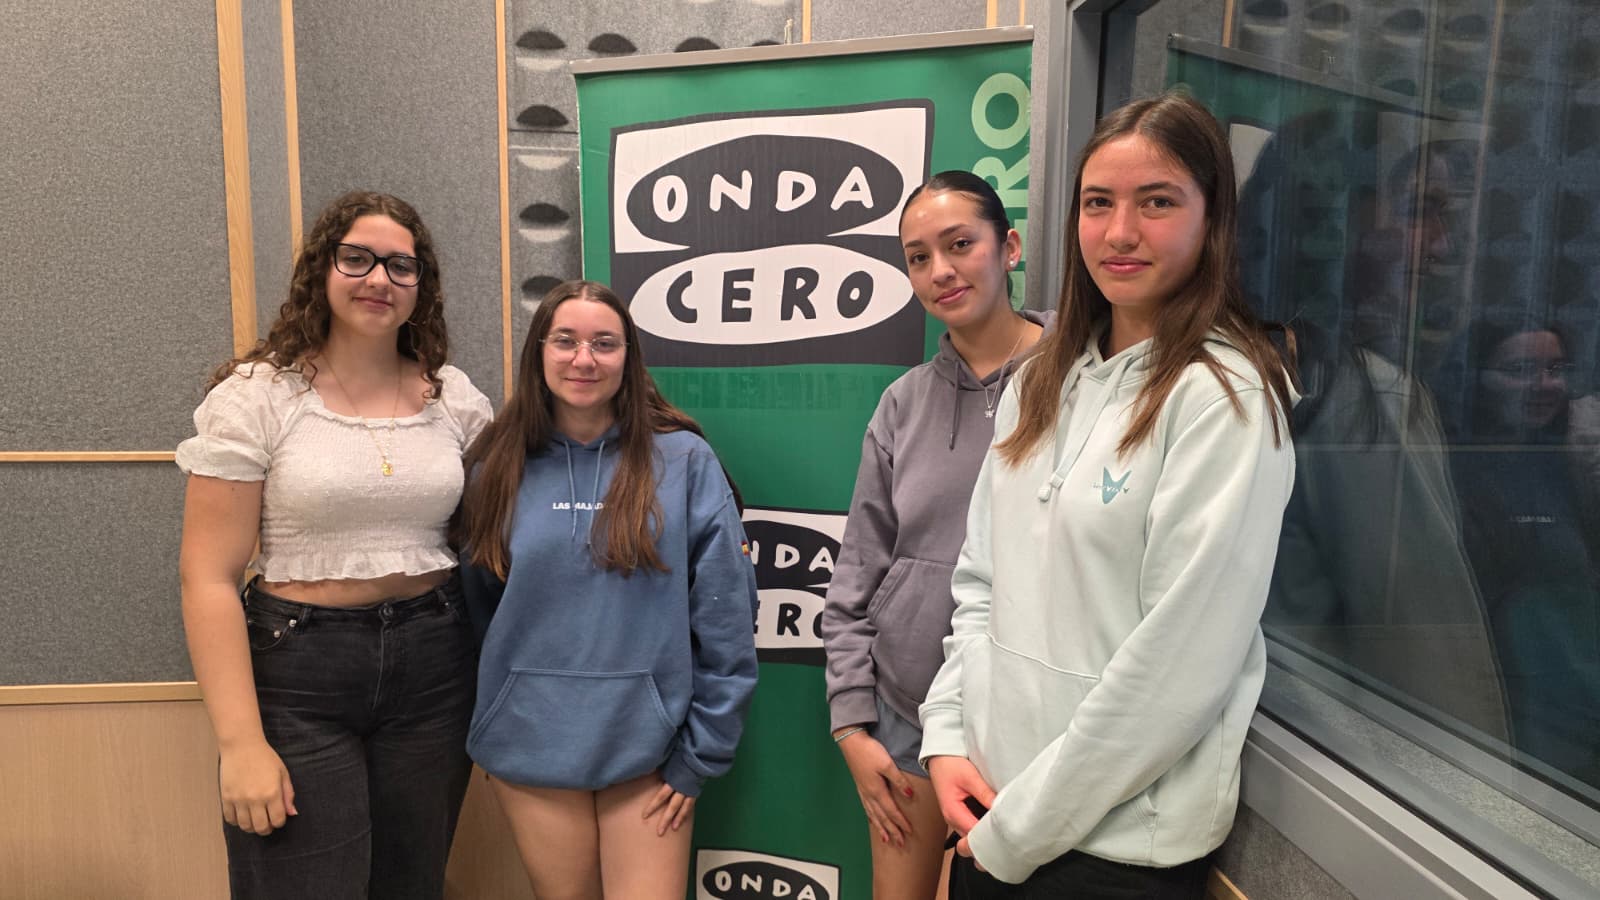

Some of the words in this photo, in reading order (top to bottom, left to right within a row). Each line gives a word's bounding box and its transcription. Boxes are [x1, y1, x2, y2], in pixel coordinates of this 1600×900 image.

[652, 166, 874, 223] ONDA
[666, 267, 874, 323] CERO
[552, 502, 571, 510] LAS
[714, 870, 817, 900] ONDA
